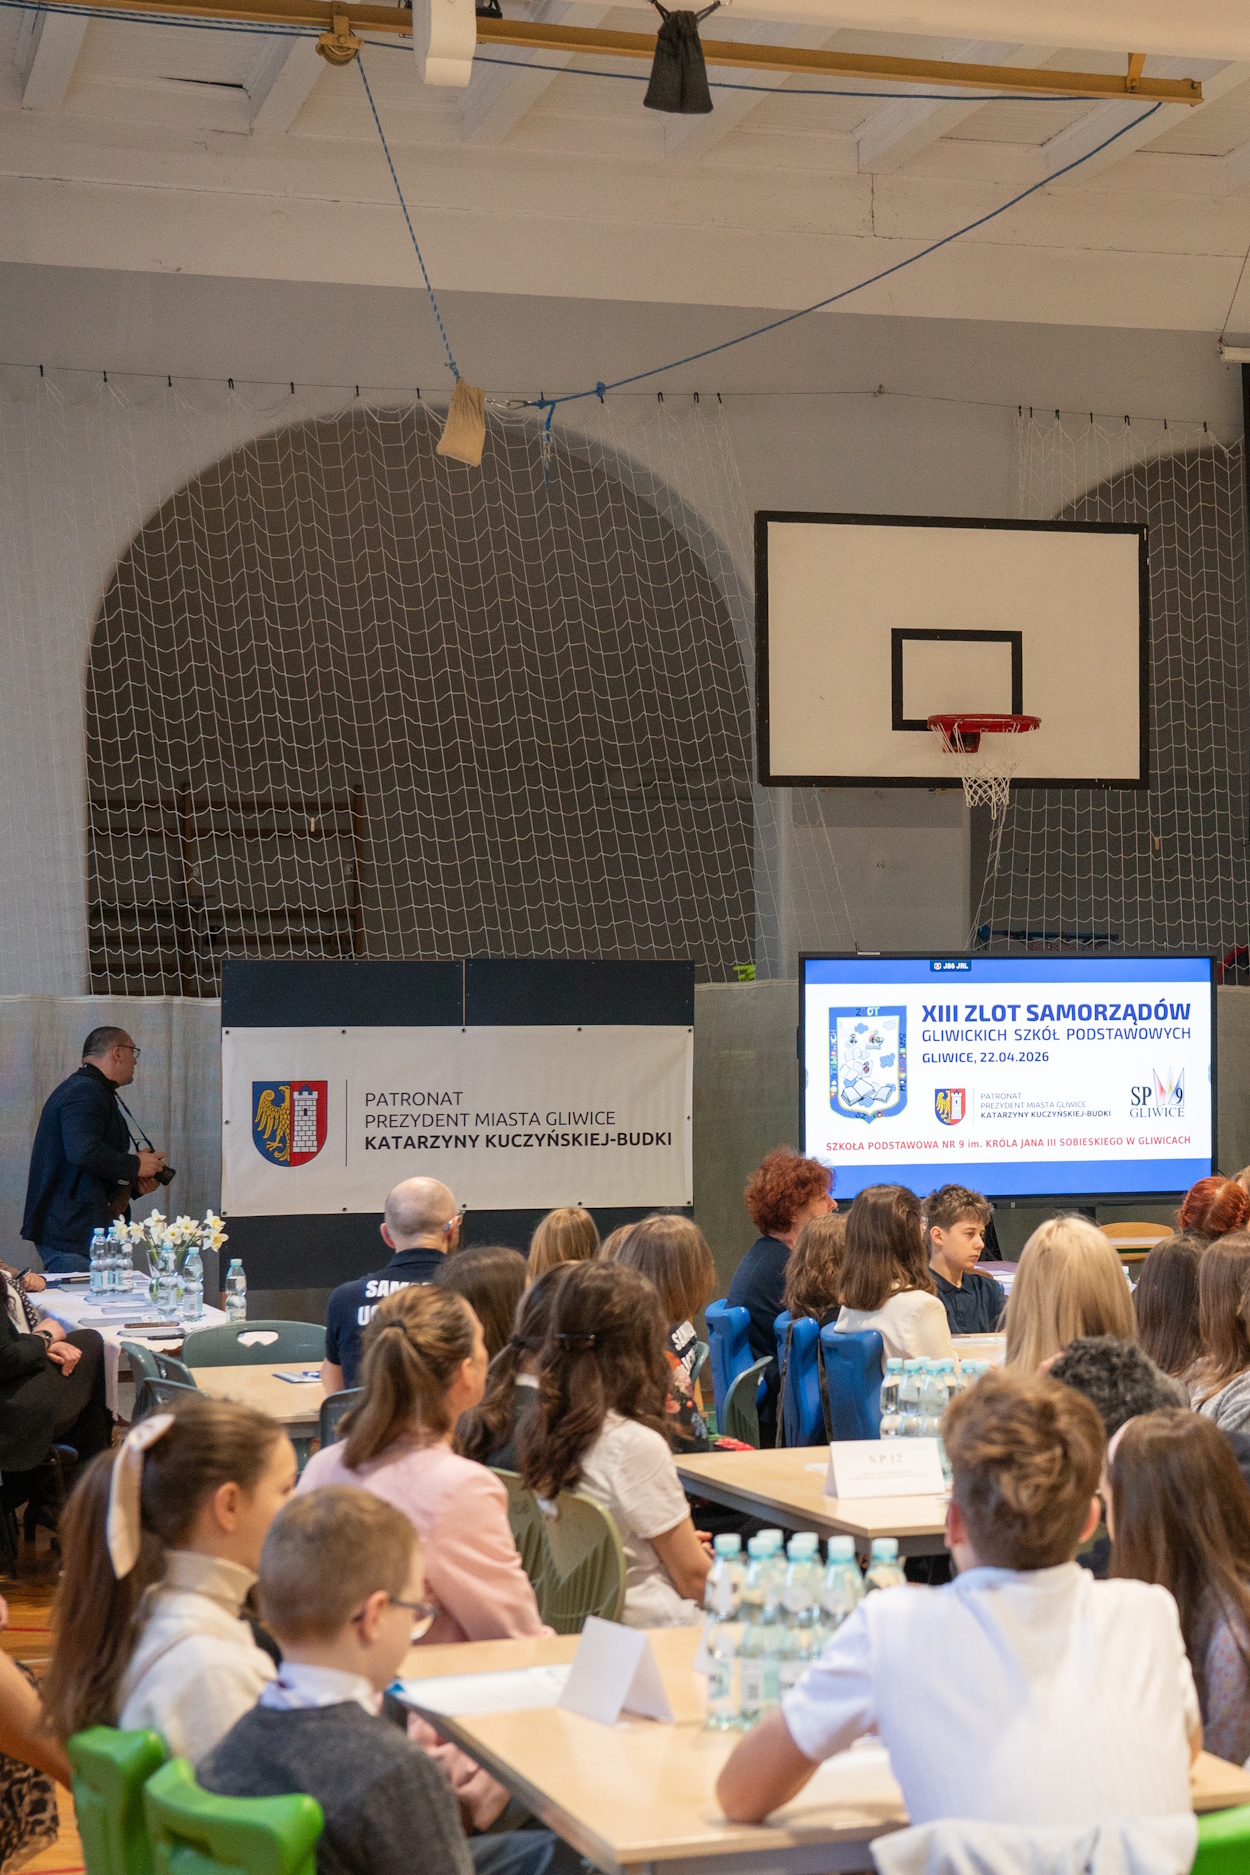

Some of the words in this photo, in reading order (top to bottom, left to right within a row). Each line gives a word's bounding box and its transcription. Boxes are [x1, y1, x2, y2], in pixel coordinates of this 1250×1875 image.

[922, 1005, 958, 1022] XIII
[965, 1005, 1021, 1022] ZLOT
[1027, 998, 1190, 1025] SAMORZĄDÓW
[923, 1029, 1006, 1041] GLIWICKICH
[1015, 1026, 1060, 1041] SZKÓŁ
[1067, 1028, 1190, 1040] PODSTAWOWYCH
[923, 1053, 976, 1063] GLIWICE,
[981, 1052, 1048, 1062] 22.04.2026
[366, 1092, 463, 1106] PATRONAT
[1131, 1087, 1151, 1106] SP
[1175, 1088, 1183, 1103] 9
[366, 1113, 470, 1128] PREZYDENT
[475, 1112, 541, 1127] MIASTA
[546, 1111, 615, 1125] GLIWICE
[1031, 1108, 1111, 1118] KUCZYŃSKIEJ-BUDKI
[1130, 1107, 1184, 1117] GLIWICE
[366, 1135, 479, 1150] KATARZYNY
[486, 1129, 671, 1147] KUCZYŃSKIEJ-BUDKI
[827, 1143, 864, 1151] SZKOŁA
[868, 1141, 938, 1150] PODSTAWOWA
[959, 1140, 964, 1148] 9
[986, 1137, 1018, 1148] KRÓLA
[1020, 1139, 1044, 1148] JANA
[1060, 1137, 1123, 1146] SOBIESKIEGO
[1139, 1136, 1190, 1144] GLIWICACH
